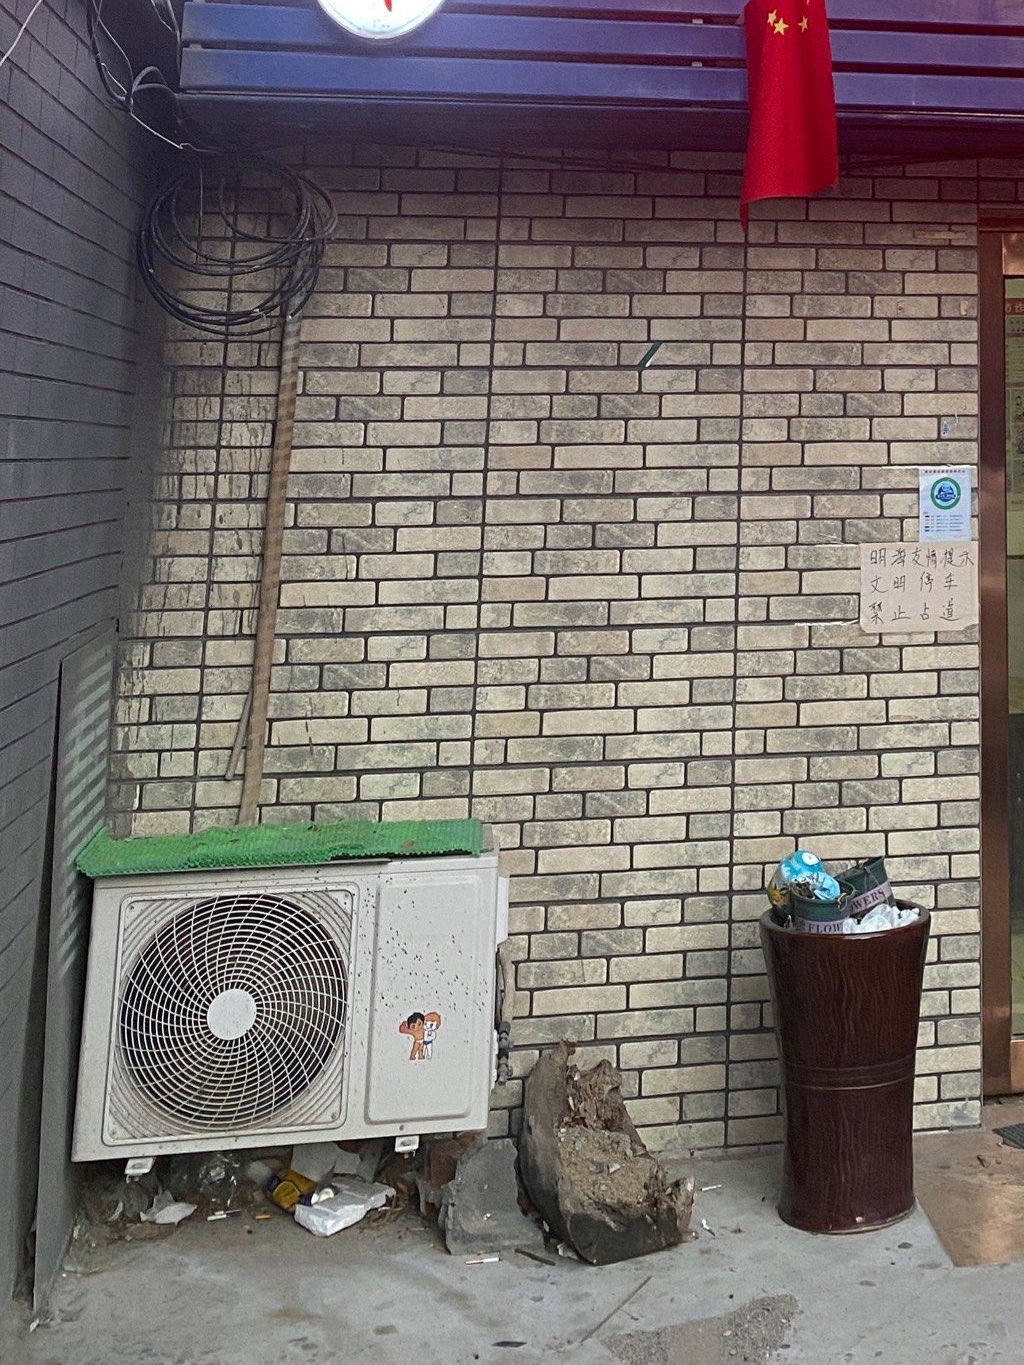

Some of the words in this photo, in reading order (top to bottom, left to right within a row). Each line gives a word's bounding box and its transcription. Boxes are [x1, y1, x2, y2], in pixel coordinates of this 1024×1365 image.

[870, 571, 959, 593] 文明停车
[868, 597, 961, 625] 禁止占道
